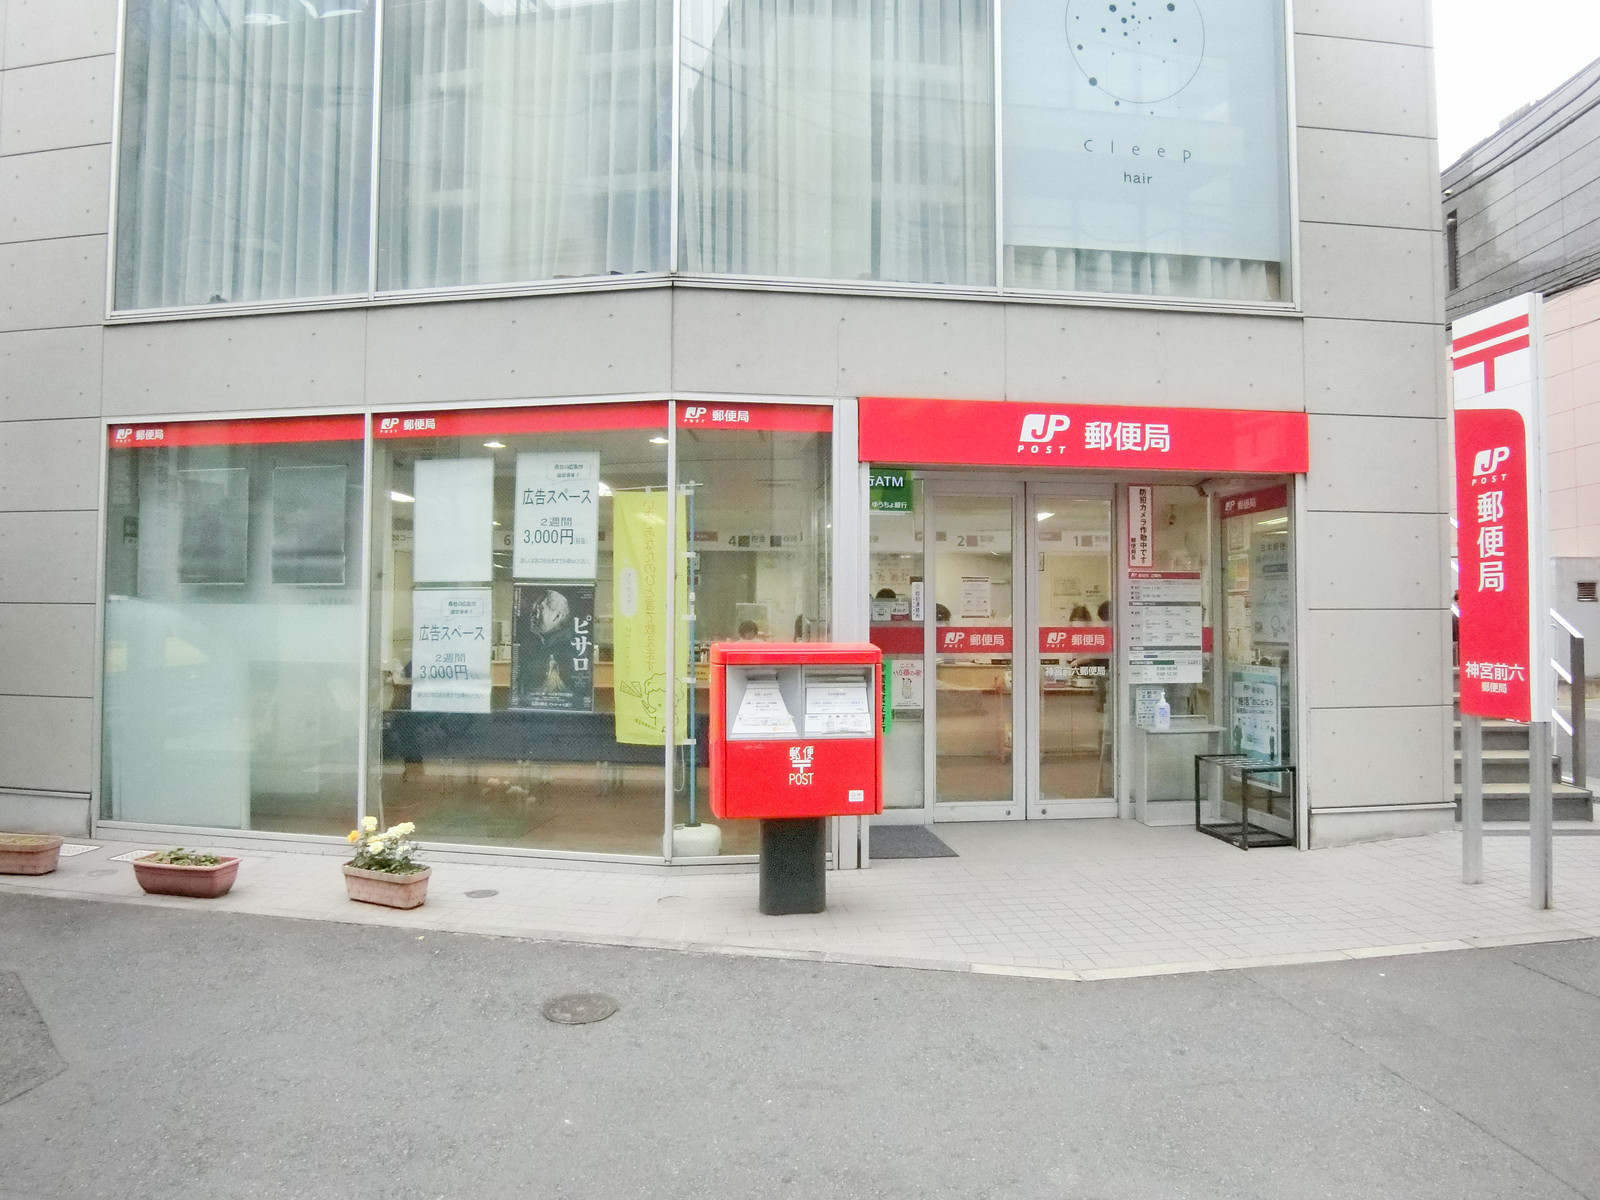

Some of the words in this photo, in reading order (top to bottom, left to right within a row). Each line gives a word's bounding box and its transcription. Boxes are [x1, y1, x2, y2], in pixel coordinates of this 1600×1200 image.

[1124, 171, 1152, 184] hair
[685, 407, 707, 418] JP
[712, 410, 749, 422] 郵便局
[381, 418, 399, 429] JP
[403, 418, 436, 430] 郵便局
[116, 428, 132, 439] JP
[135, 429, 164, 440] 郵便局
[1020, 414, 1070, 442] JP
[1085, 421, 1170, 452] 郵便局
[1018, 445, 1066, 454] POST
[1473, 446, 1510, 477] JP
[1471, 473, 1507, 486] POST
[522, 488, 592, 506] 広告スペース
[871, 501, 908, 509] ゆうちょ銀行
[540, 517, 573, 527] 2週間
[504, 535, 511, 546] 6
[523, 529, 574, 545] 3,000円
[728, 535, 737, 546] 4
[957, 535, 965, 547] 2
[1073, 535, 1079, 547] 1
[1476, 490, 1505, 593] 郵便局
[418, 624, 485, 642] 広告スペース
[570, 615, 592, 672] ピサロ
[969, 634, 1005, 646] 郵便局
[1071, 634, 1105, 646] 郵便局
[435, 653, 466, 663] 2週間
[420, 665, 469, 680] 3,000円
[1465, 661, 1525, 682] 神宮前六
[1481, 682, 1507, 694] 郵便局
[789, 746, 814, 761] 郵便
[788, 773, 814, 785] POST
